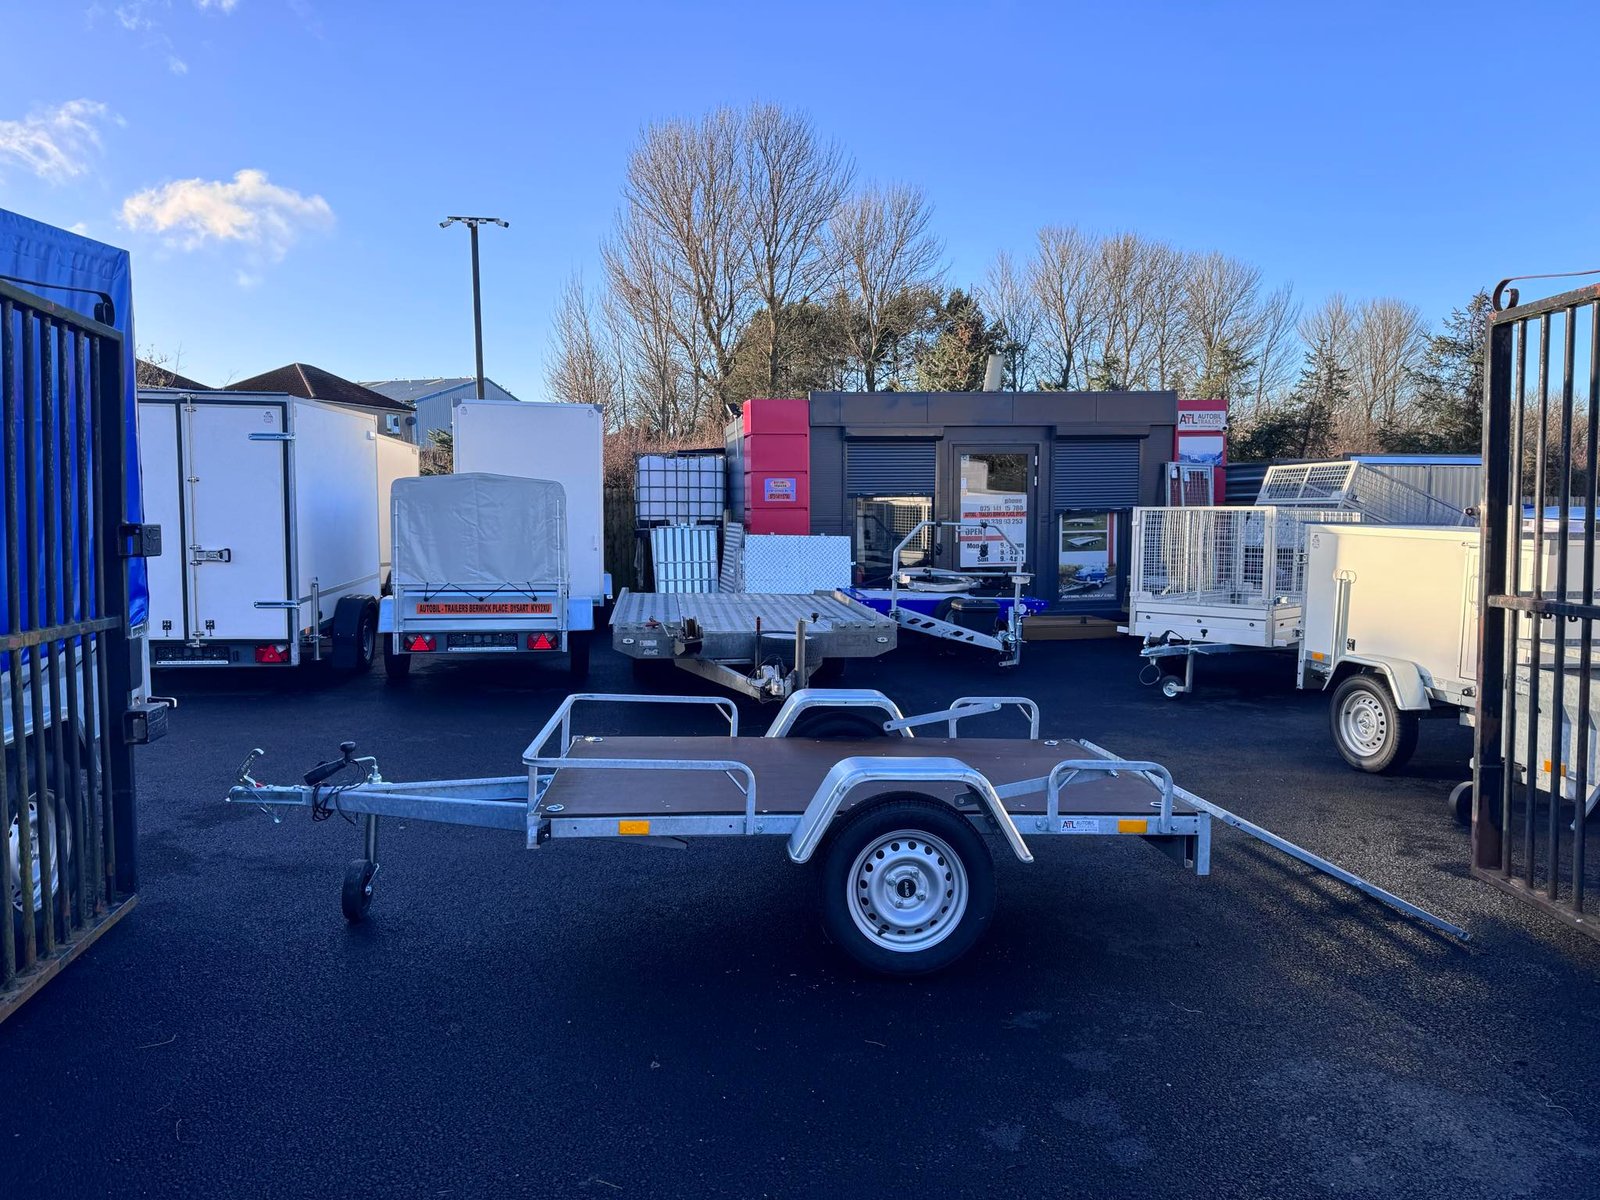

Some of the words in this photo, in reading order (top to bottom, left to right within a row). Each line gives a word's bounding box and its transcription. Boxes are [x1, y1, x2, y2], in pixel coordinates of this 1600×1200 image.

[1180, 414, 1198, 424] ATL
[419, 604, 441, 614] AUTOBIL
[445, 604, 468, 613] TRAILERS
[469, 604, 491, 613] BERWICK
[510, 604, 528, 613] DYSART
[1062, 820, 1076, 828] ATL
